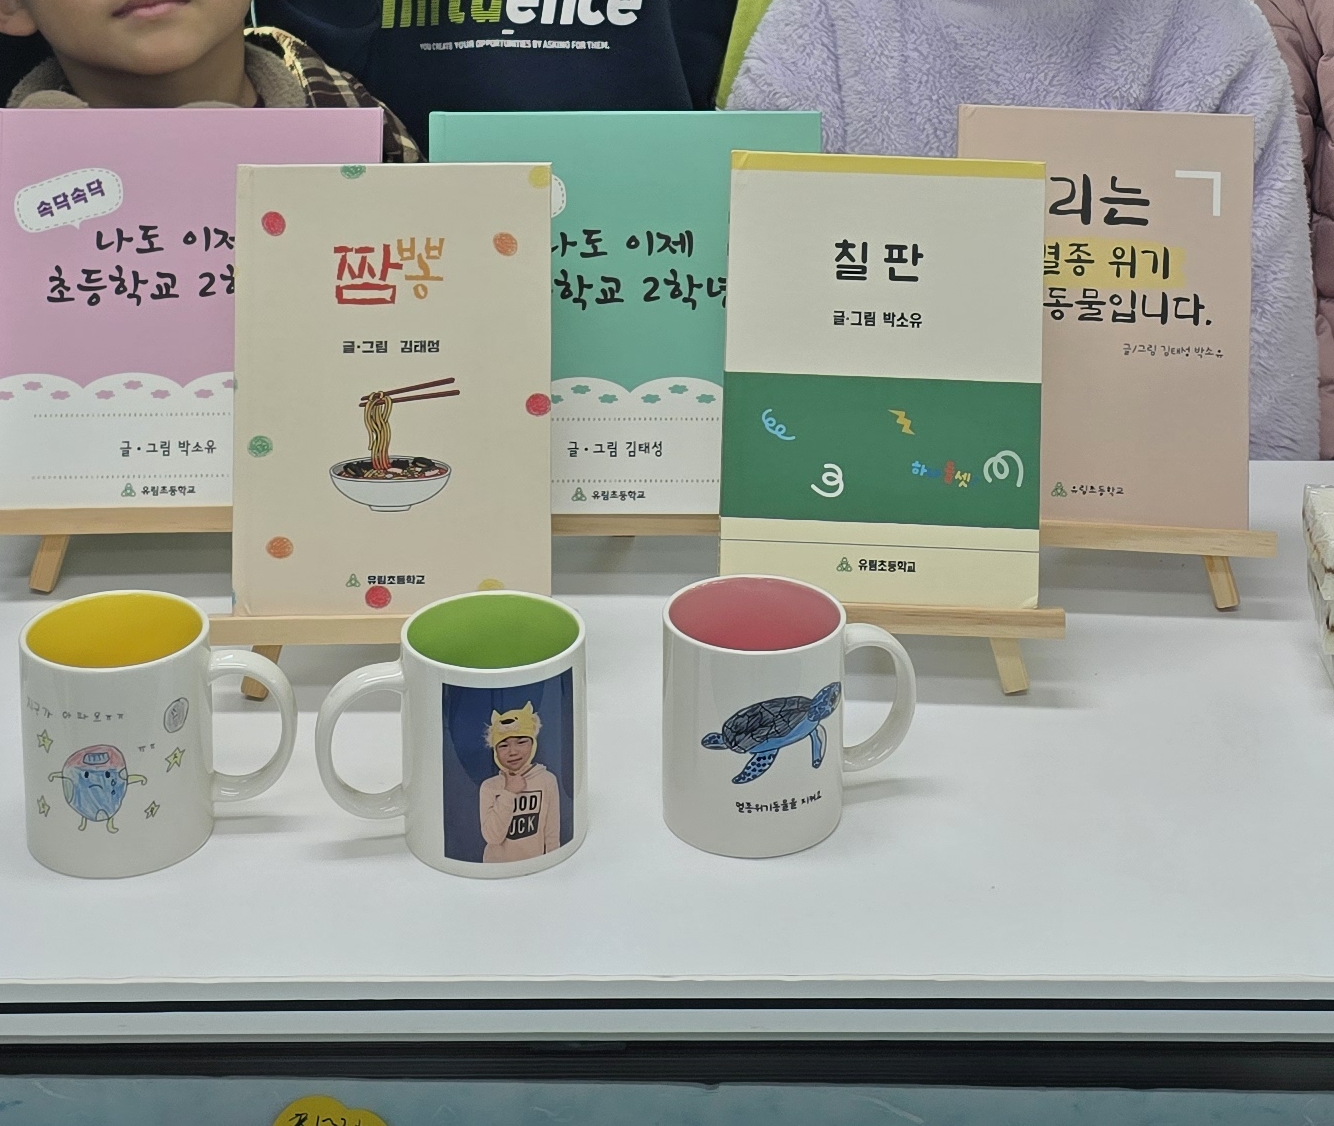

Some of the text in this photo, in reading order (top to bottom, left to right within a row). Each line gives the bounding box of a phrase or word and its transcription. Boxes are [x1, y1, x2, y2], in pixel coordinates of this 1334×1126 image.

[454, 40, 474, 49] YOUR
[532, 39, 542, 48] BY
[571, 41, 586, 49] FOR
[36, 178, 105, 218] 속닥속닥
[1048, 173, 1151, 226] 리는
[96, 225, 164, 254] 나도
[626, 230, 694, 257] 이제
[333, 236, 445, 306] 짬뽕
[1108, 245, 1170, 280] 위기
[47, 265, 180, 307] 초등학교
[552, 268, 625, 311] 학교
[1043, 287, 1212, 326] 동물입니다.
[883, 311, 923, 329] 박소유
[400, 340, 440, 354] 김태성
[1194, 346, 1224, 359] 박소유
[178, 439, 217, 456] 박소유
[625, 441, 663, 457] 김태성
[591, 490, 646, 501] 유림초등학교
[858, 558, 917, 573] 유림초등학교
[367, 574, 426, 586] 유림초등학교
[513, 794, 538, 813] OD
[509, 815, 536, 836] UCK
